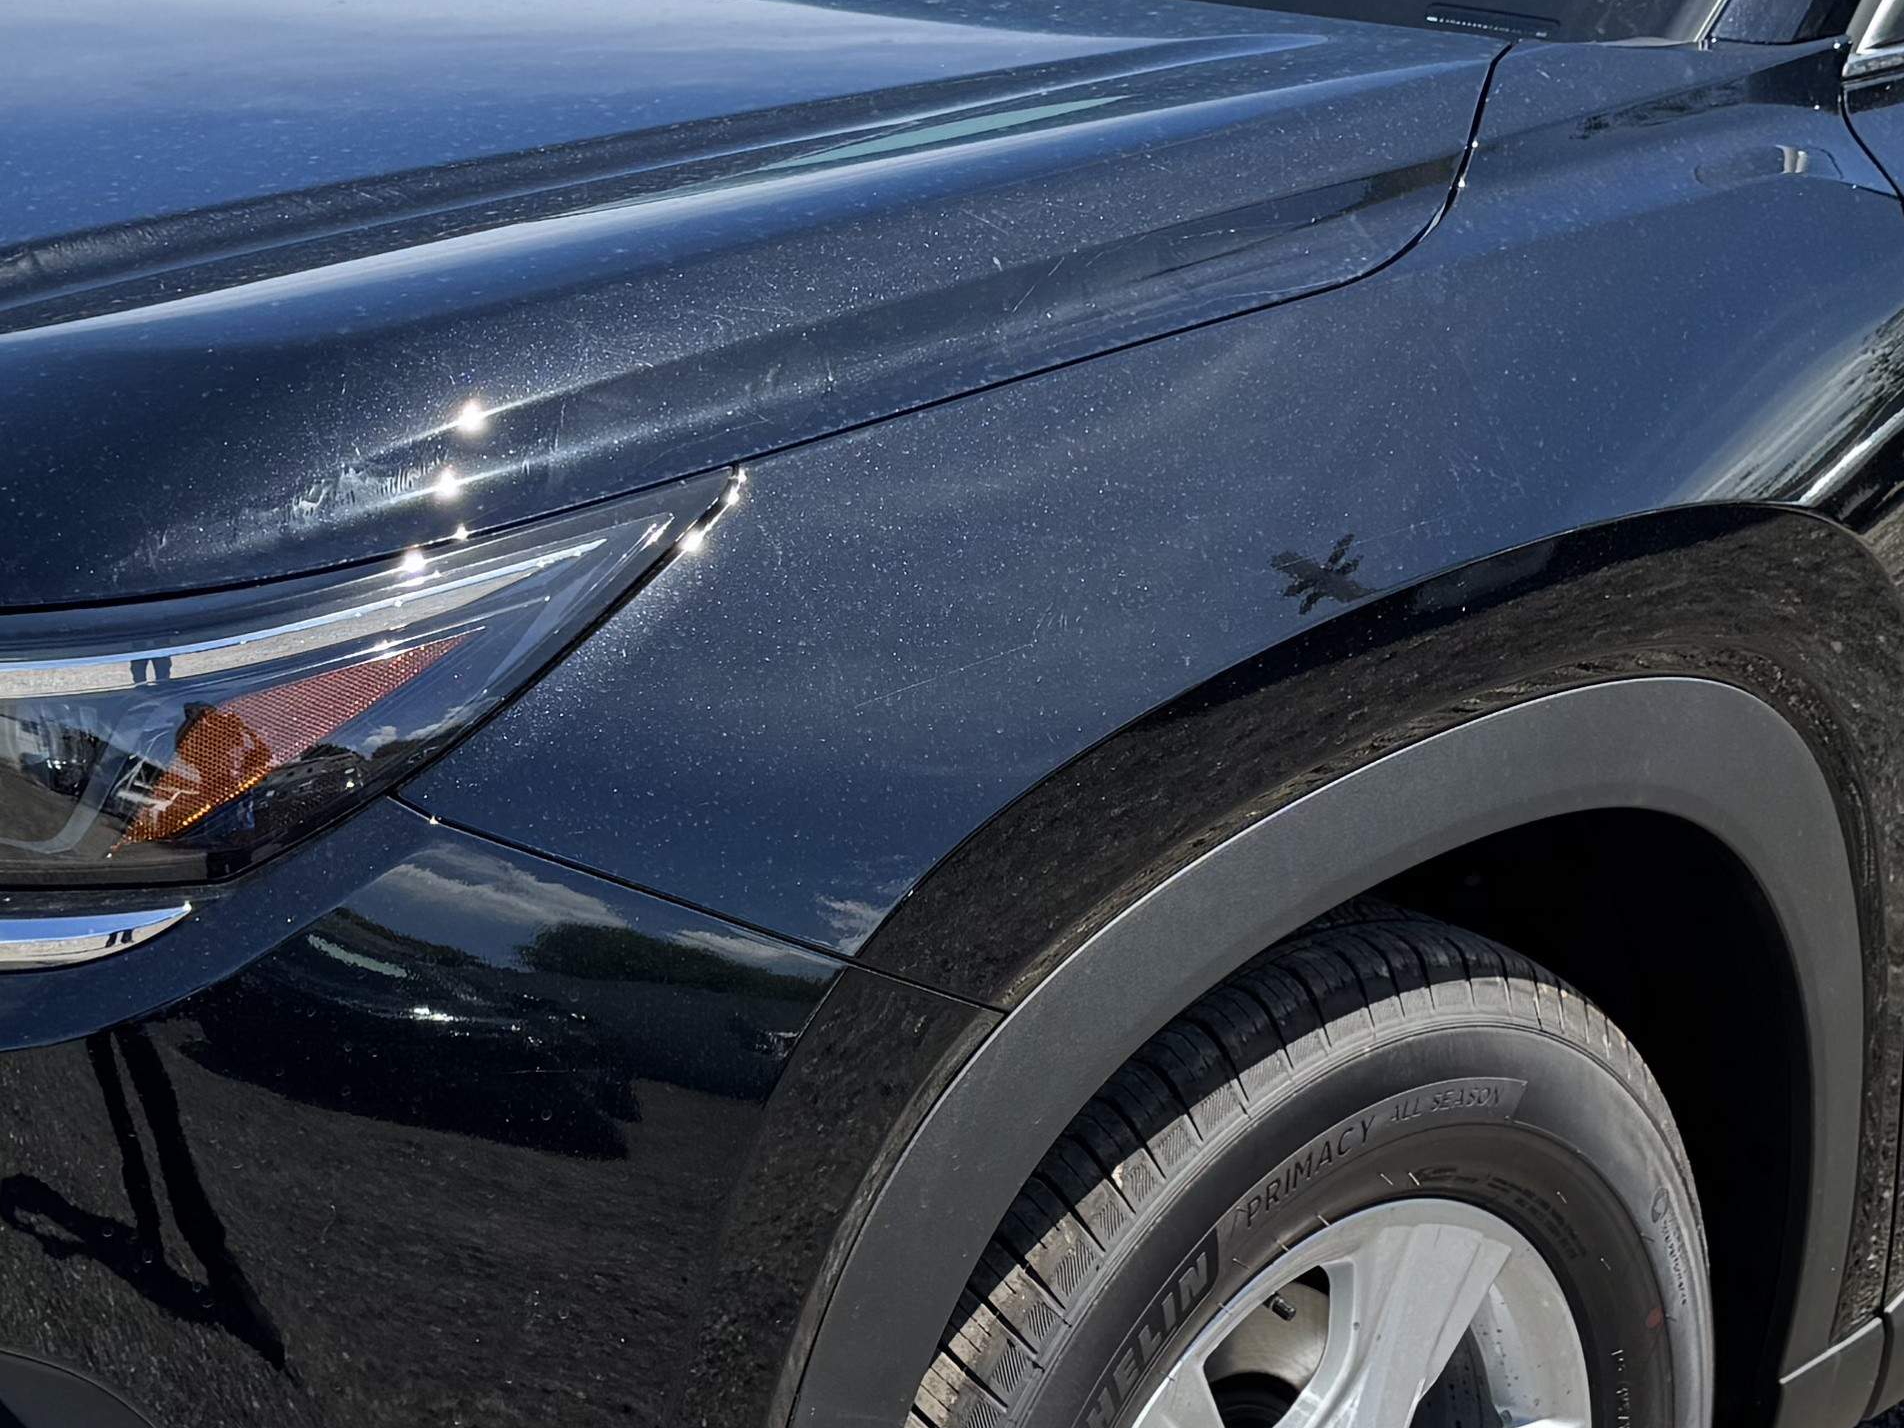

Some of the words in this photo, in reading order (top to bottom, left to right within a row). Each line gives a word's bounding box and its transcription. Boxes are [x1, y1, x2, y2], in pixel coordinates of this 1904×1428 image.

[1243, 1117, 1375, 1229] PRIMACY
[1389, 1102, 1424, 1123] ALL
[1429, 1086, 1505, 1113] SEASON
